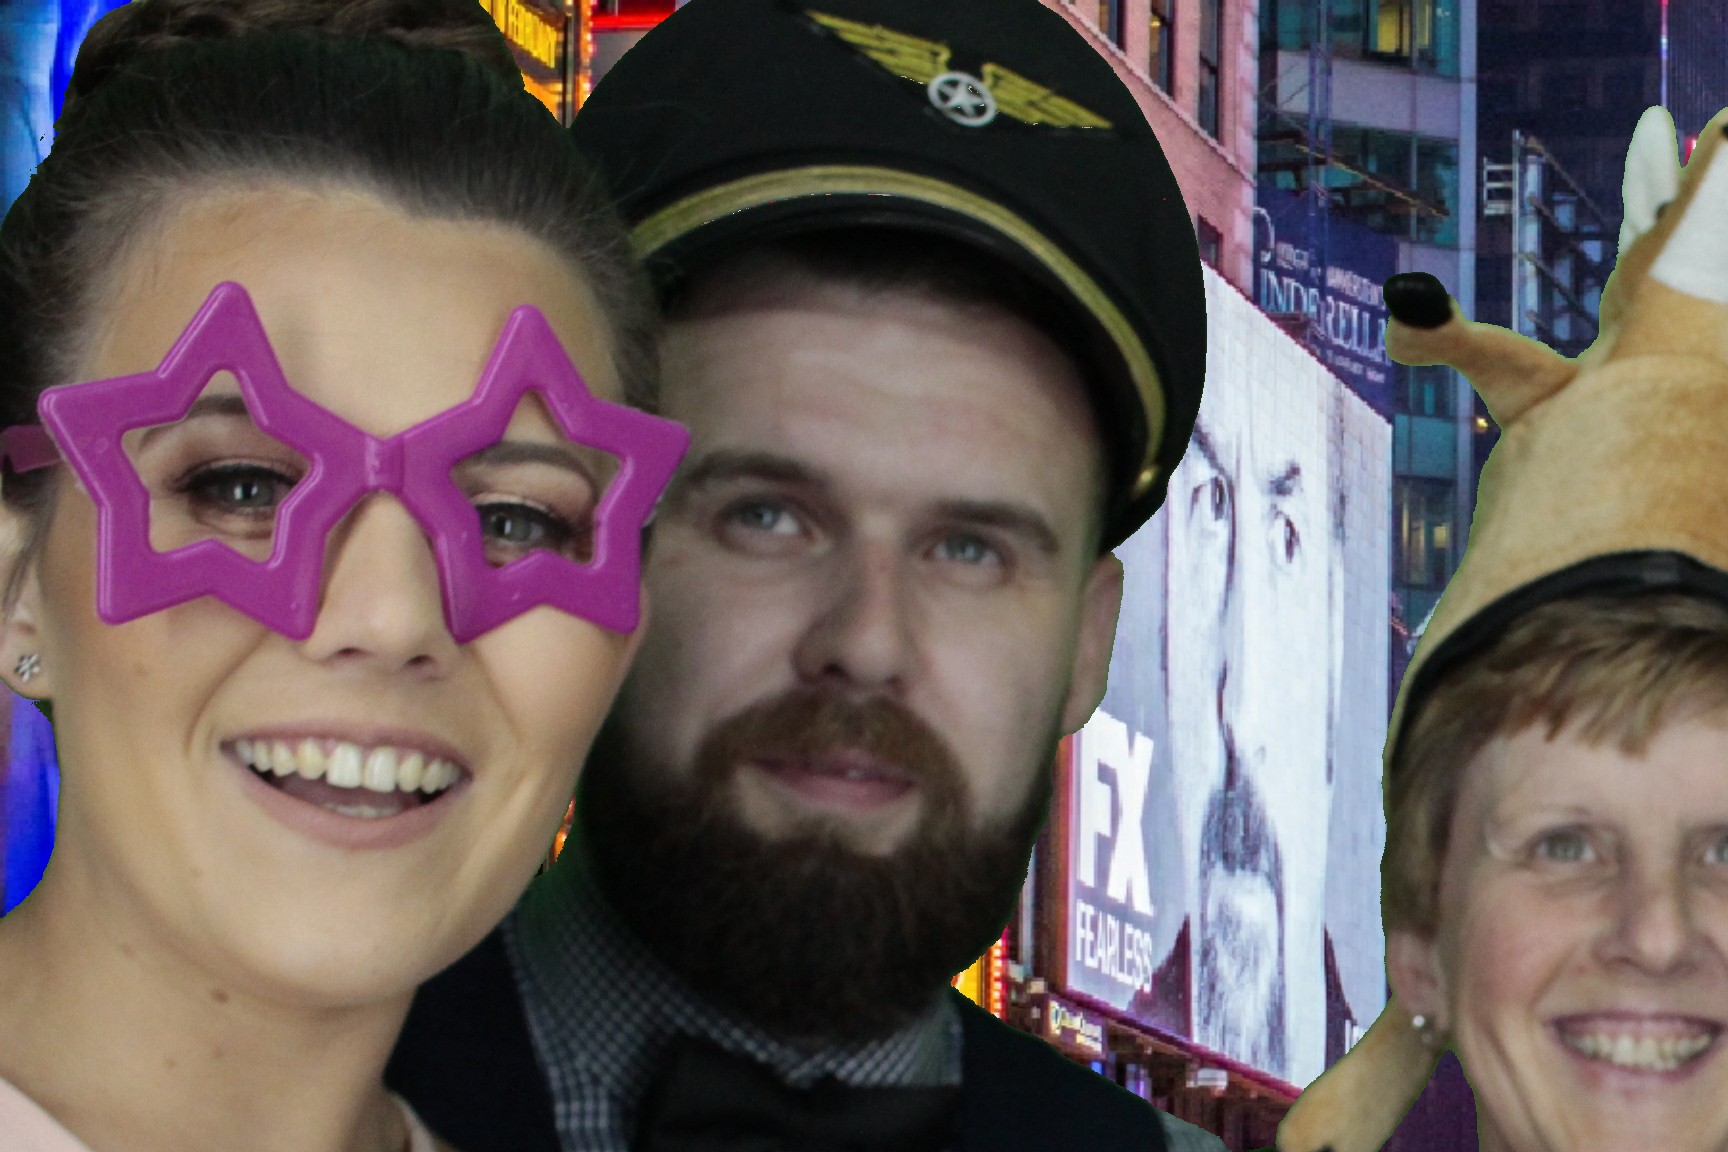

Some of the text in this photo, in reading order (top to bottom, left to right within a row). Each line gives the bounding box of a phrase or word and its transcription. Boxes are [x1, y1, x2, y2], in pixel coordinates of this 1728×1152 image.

[1260, 268, 1393, 367] INDERELLA
[1078, 708, 1154, 918] FX
[1074, 899, 1153, 994] FEARLESS
